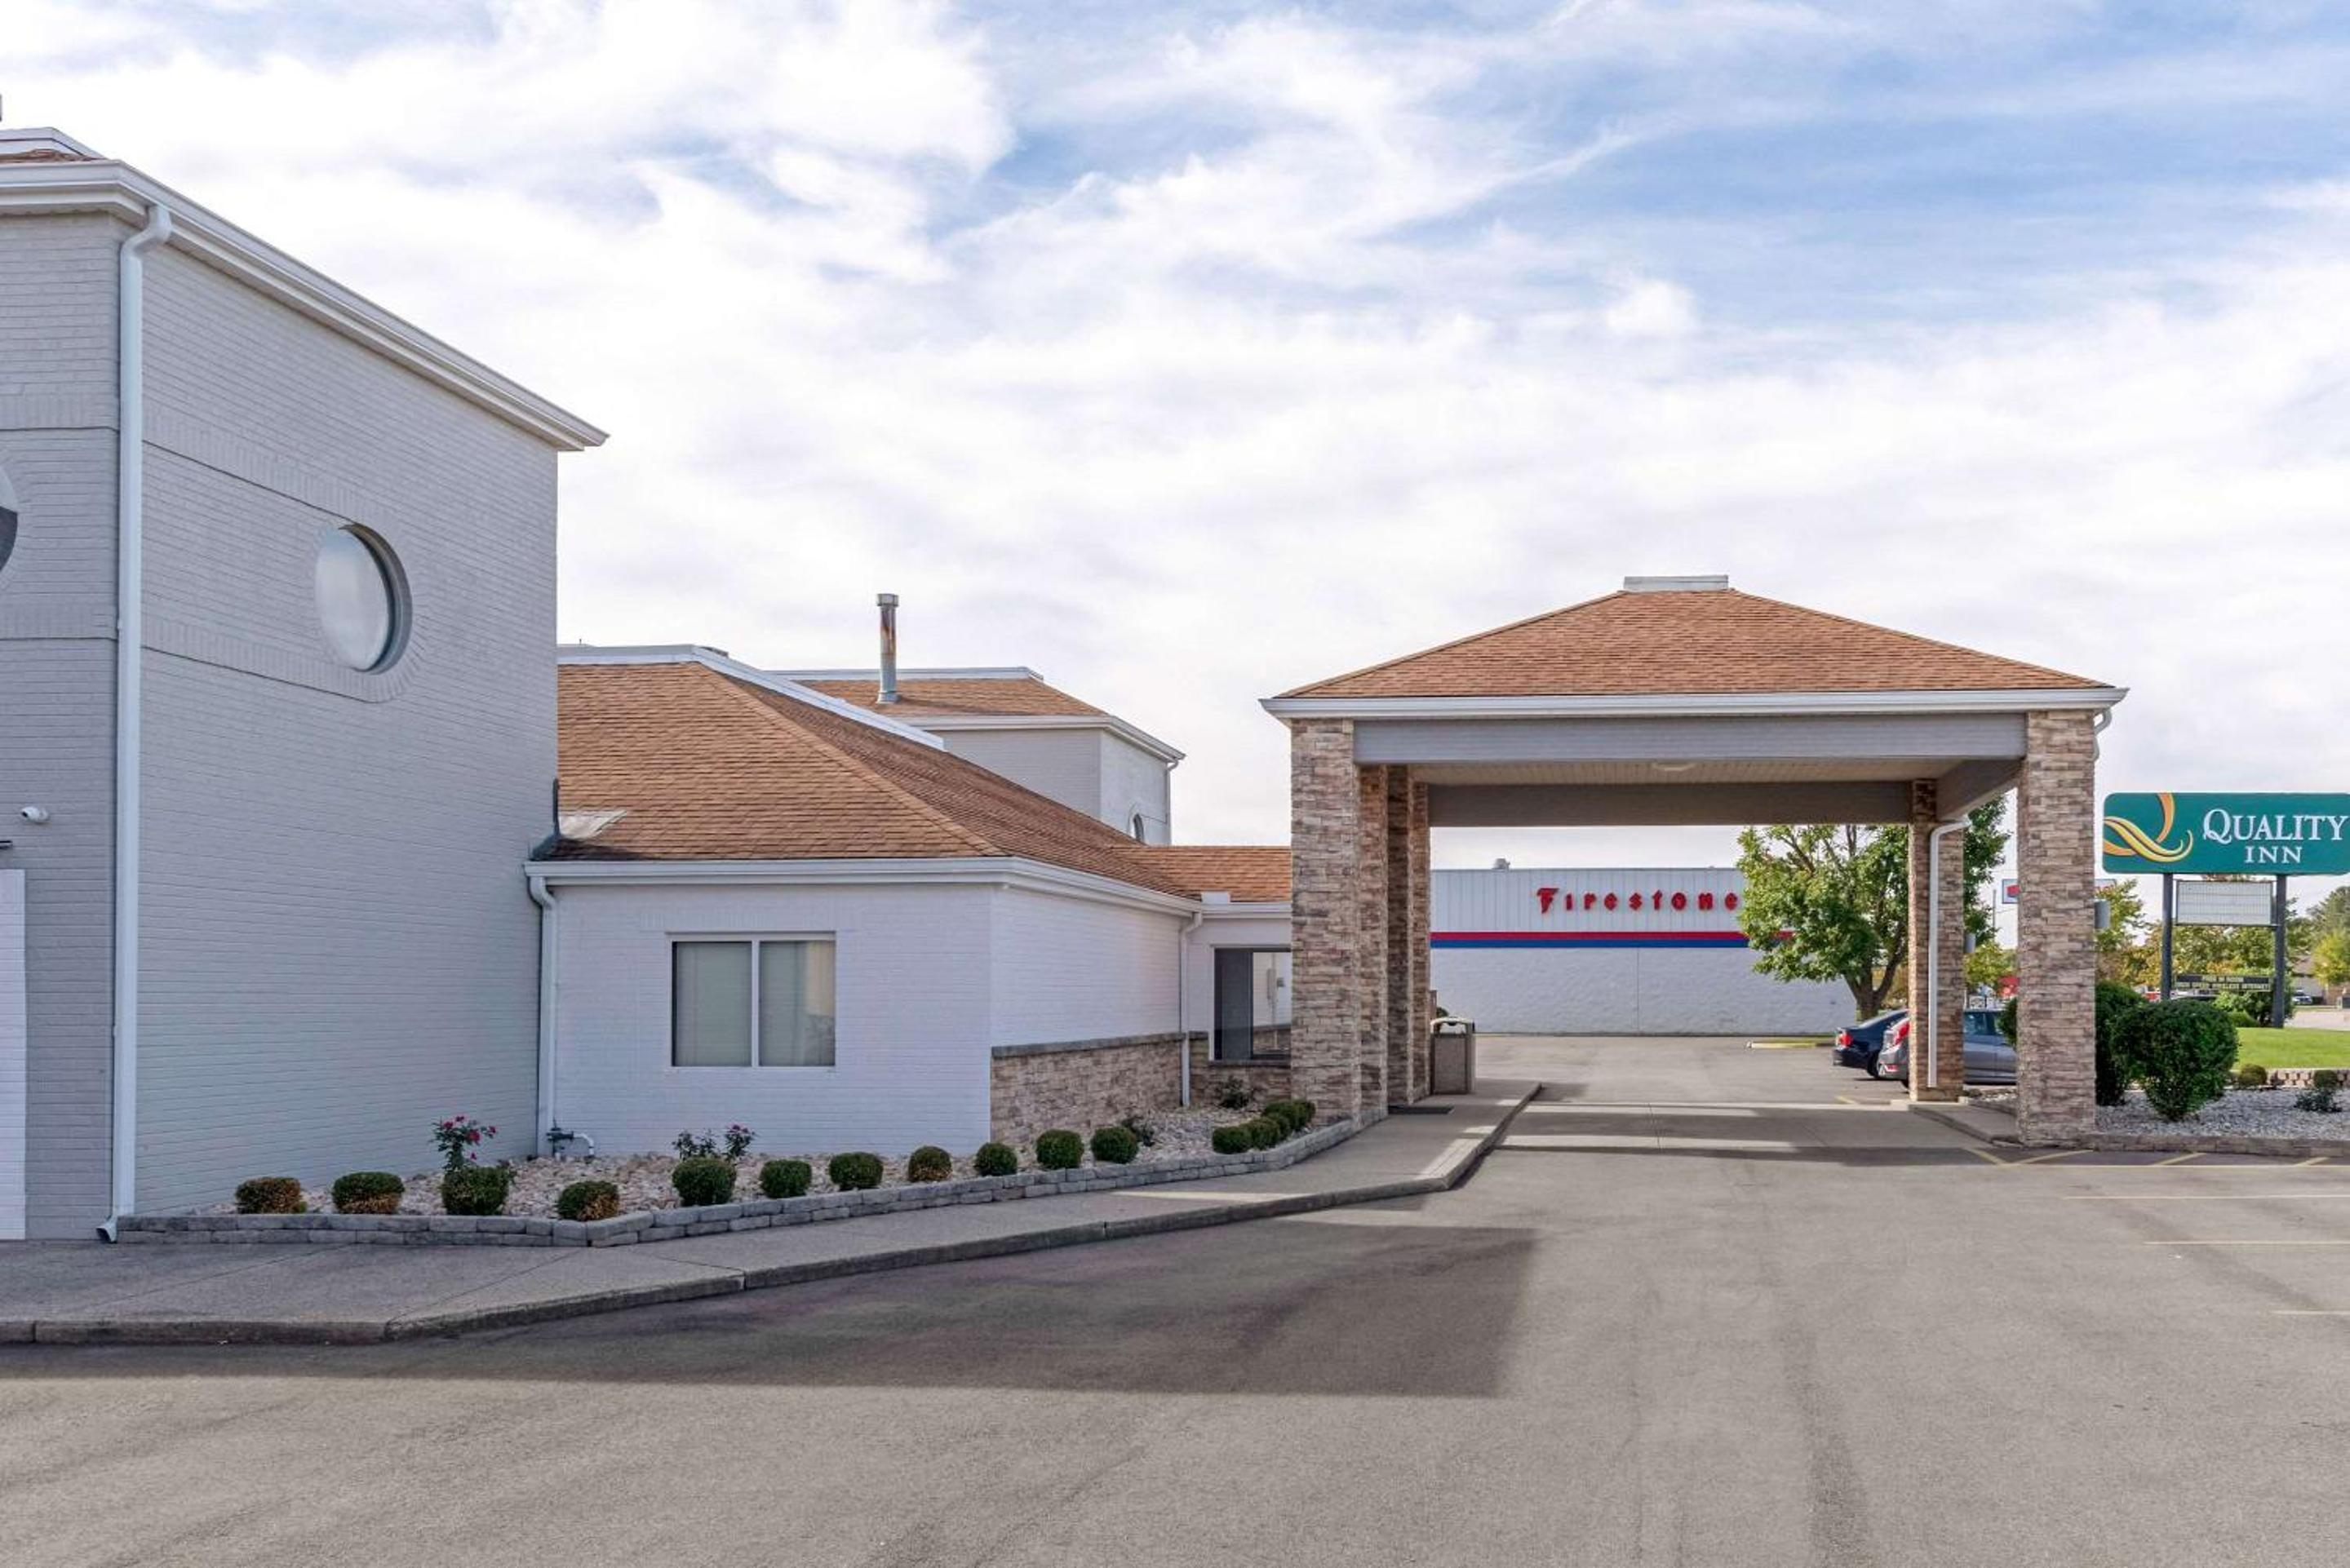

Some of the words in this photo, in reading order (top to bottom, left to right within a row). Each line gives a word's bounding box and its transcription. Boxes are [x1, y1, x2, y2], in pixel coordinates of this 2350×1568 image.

[2203, 808, 2348, 844] QUALITY
[2245, 846, 2302, 863] INN
[1536, 888, 1737, 914] Firestone
